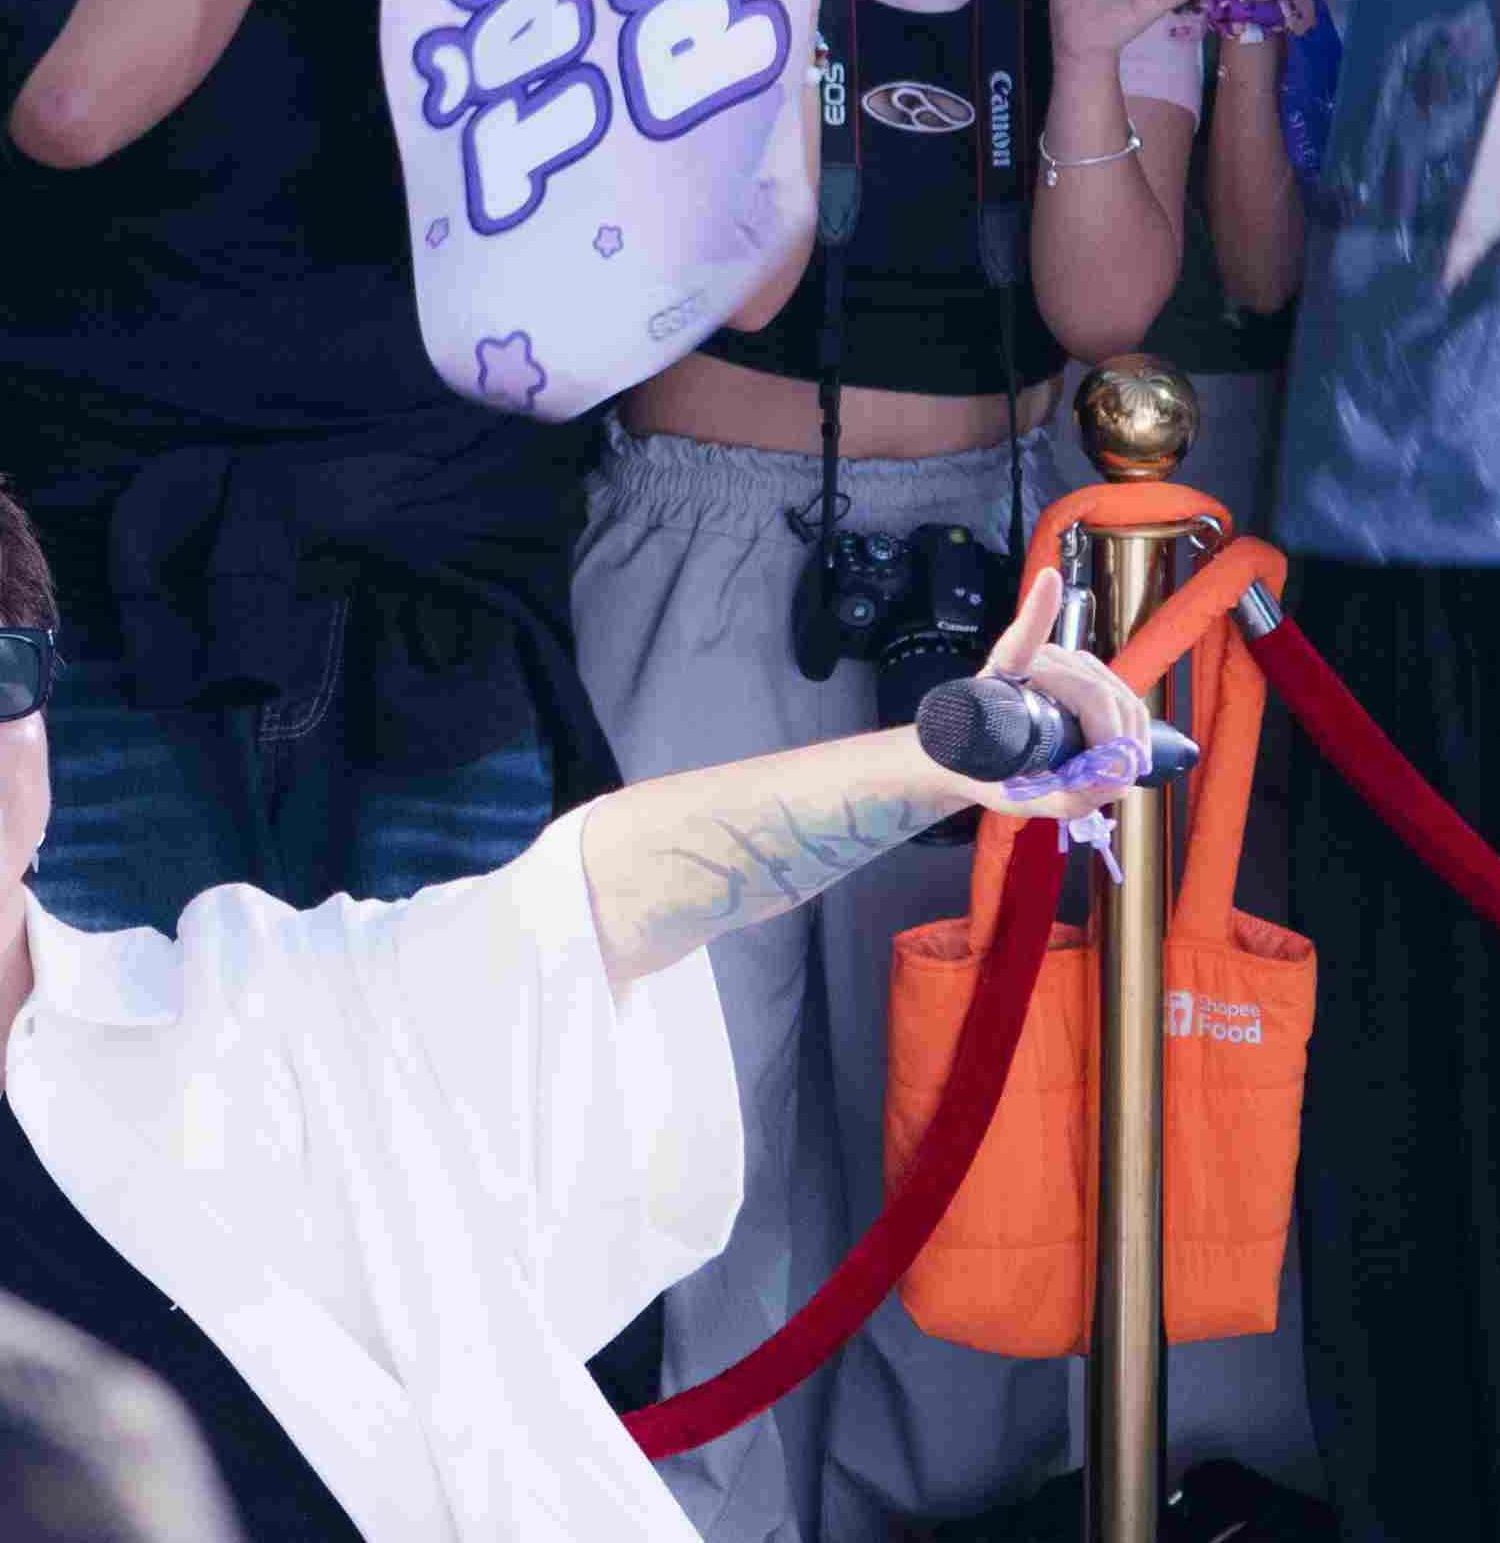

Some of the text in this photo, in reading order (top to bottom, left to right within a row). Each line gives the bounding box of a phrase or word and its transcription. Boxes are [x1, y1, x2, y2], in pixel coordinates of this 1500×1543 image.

[824, 62, 846, 127] EOS
[987, 69, 1013, 168] Canon
[1198, 1018, 1263, 1045] Food
